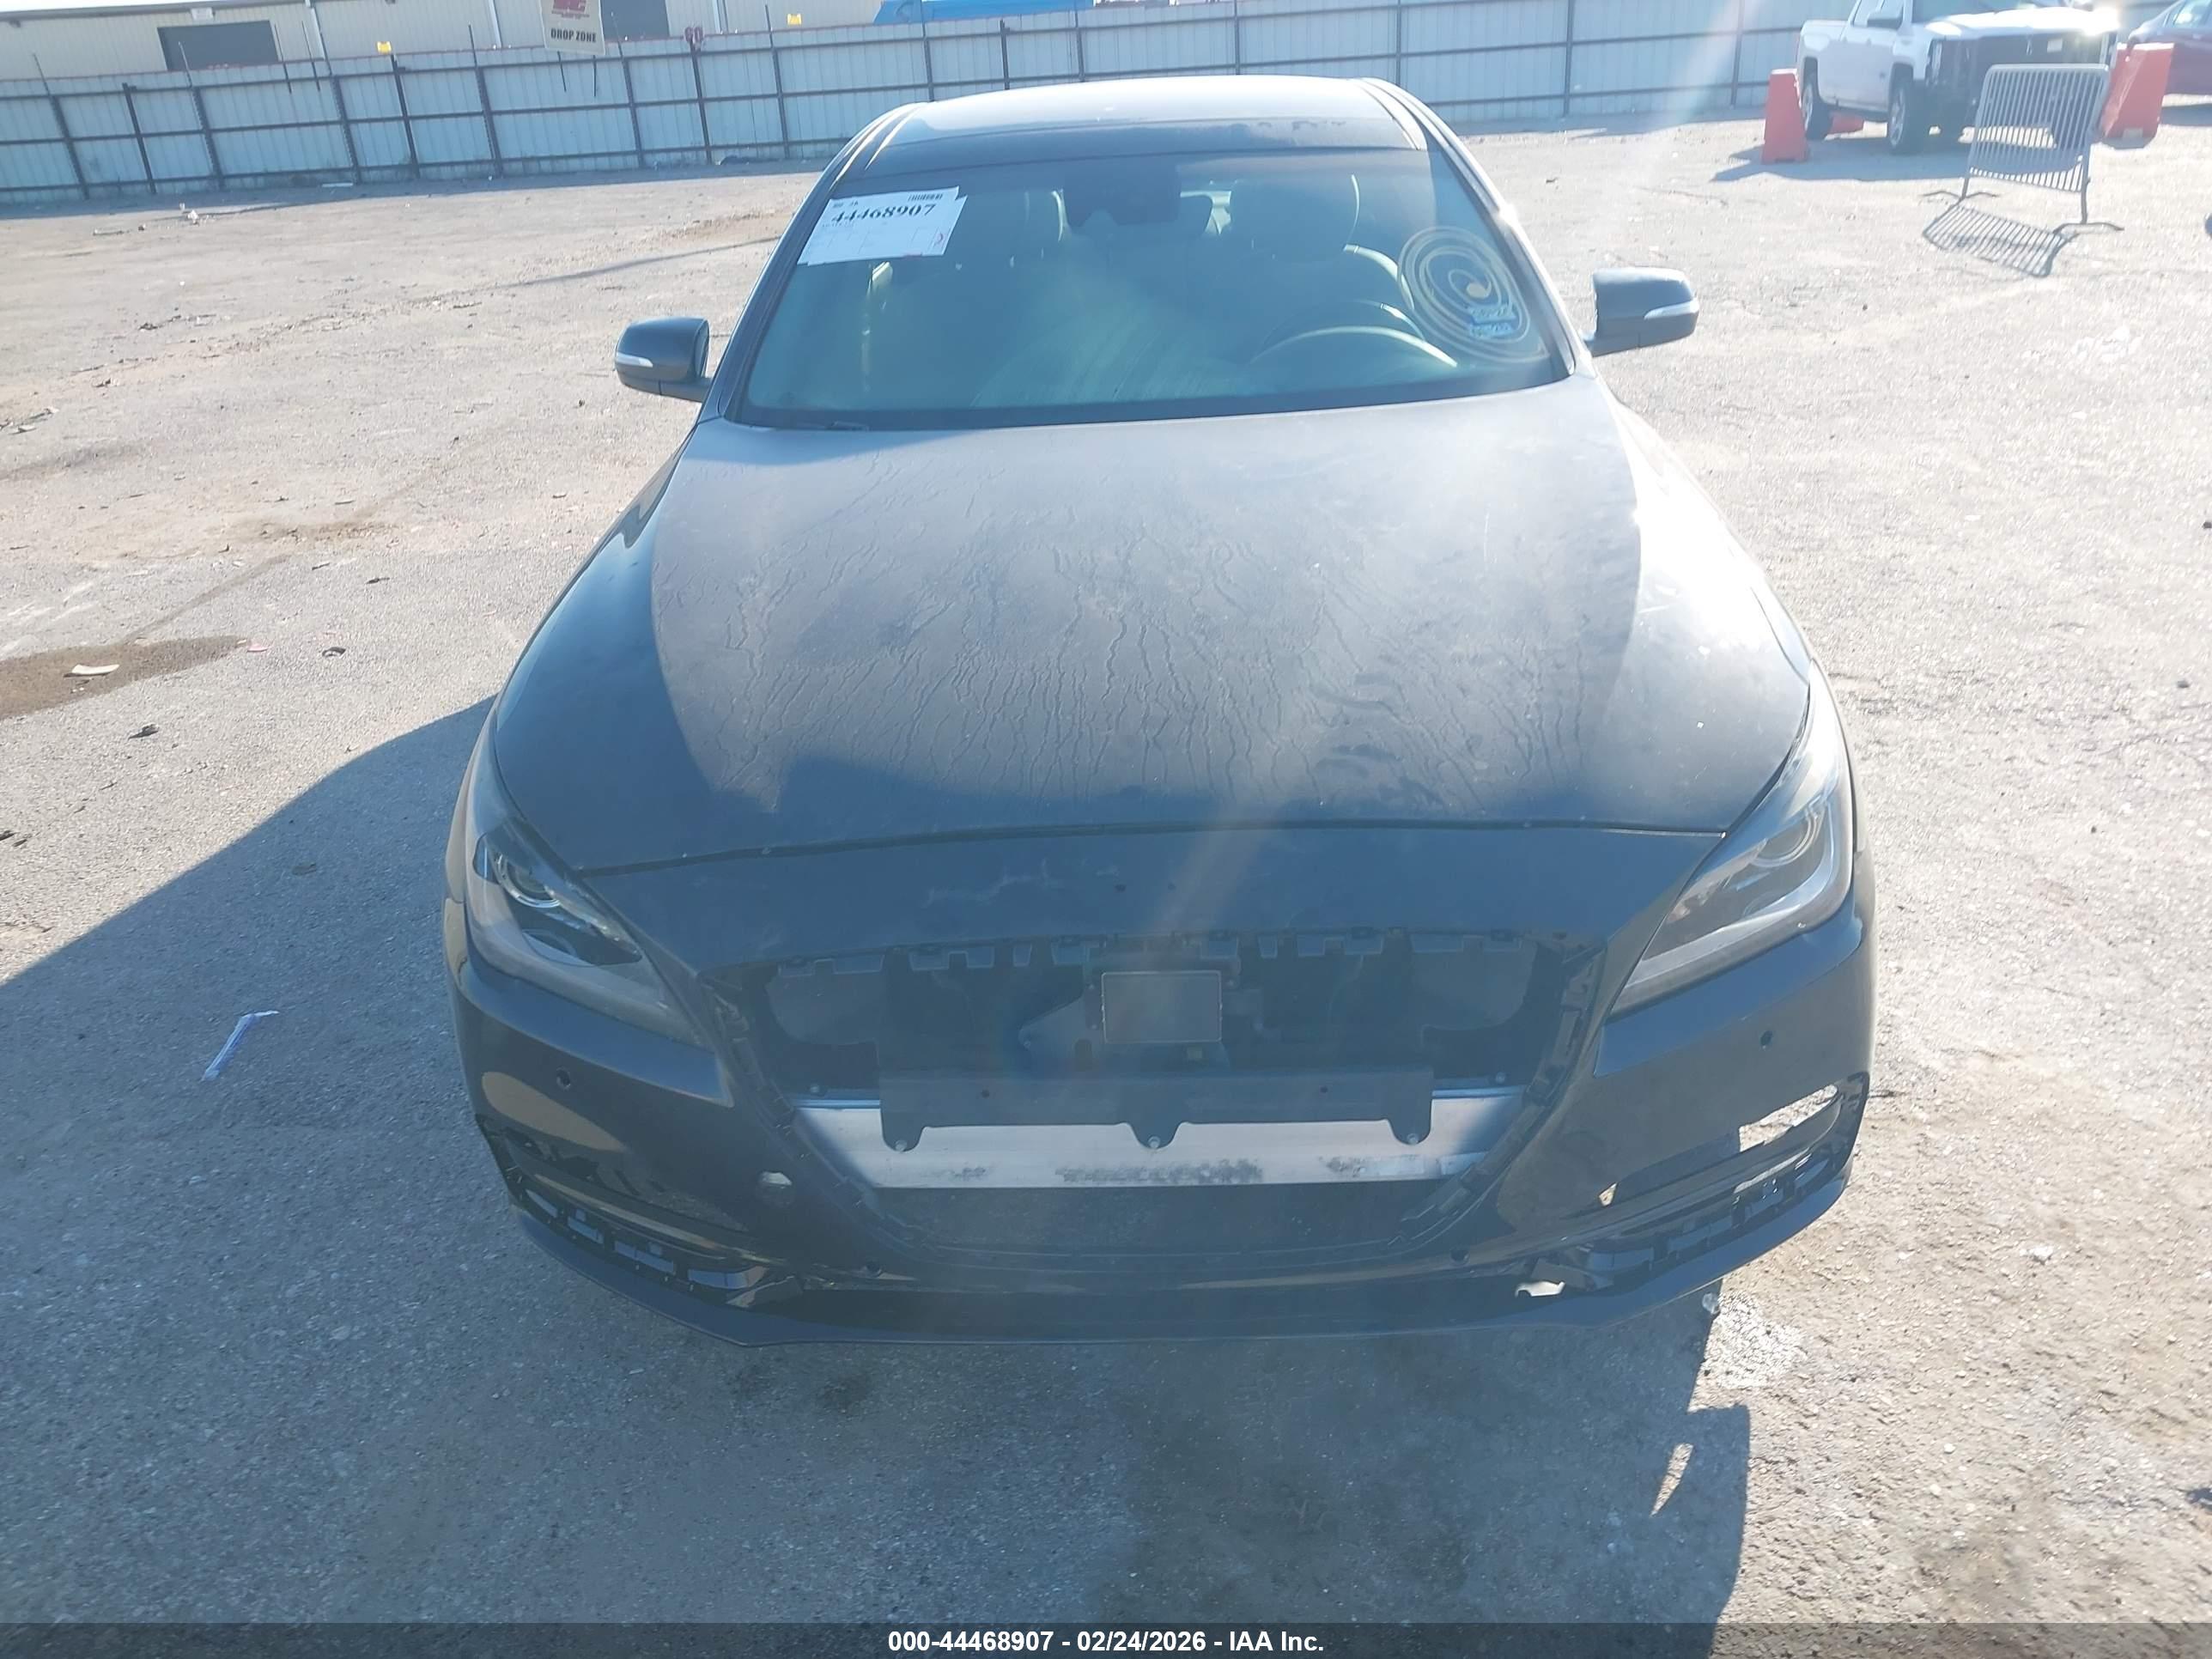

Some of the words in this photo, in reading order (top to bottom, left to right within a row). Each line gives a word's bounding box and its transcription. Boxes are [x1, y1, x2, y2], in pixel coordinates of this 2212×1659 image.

[550, 27, 574, 40] DROP
[575, 31, 597, 43] ZONE
[831, 204, 936, 223] 44468907
